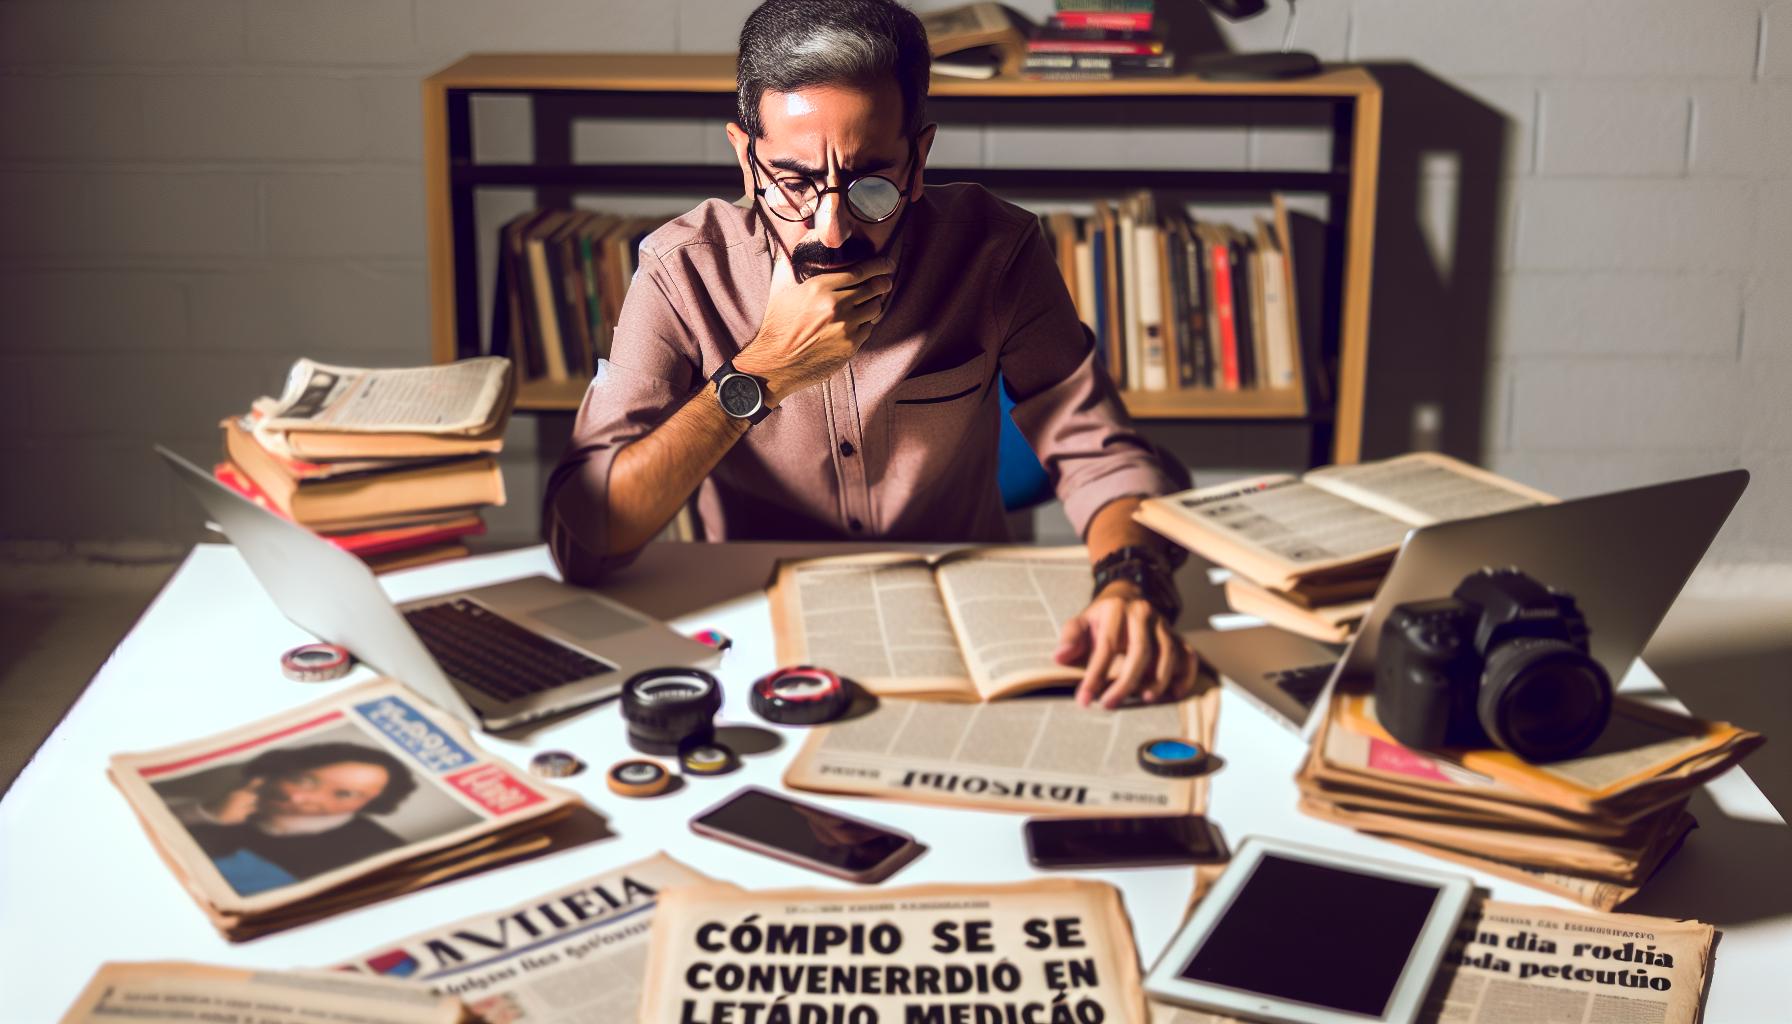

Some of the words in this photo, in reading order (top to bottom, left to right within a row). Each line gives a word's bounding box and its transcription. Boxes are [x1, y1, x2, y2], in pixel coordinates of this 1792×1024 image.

[695, 915, 904, 955] CÓMPIO
[930, 920, 995, 954] SE
[1022, 916, 1087, 949] SE
[1044, 957, 1099, 990] EN
